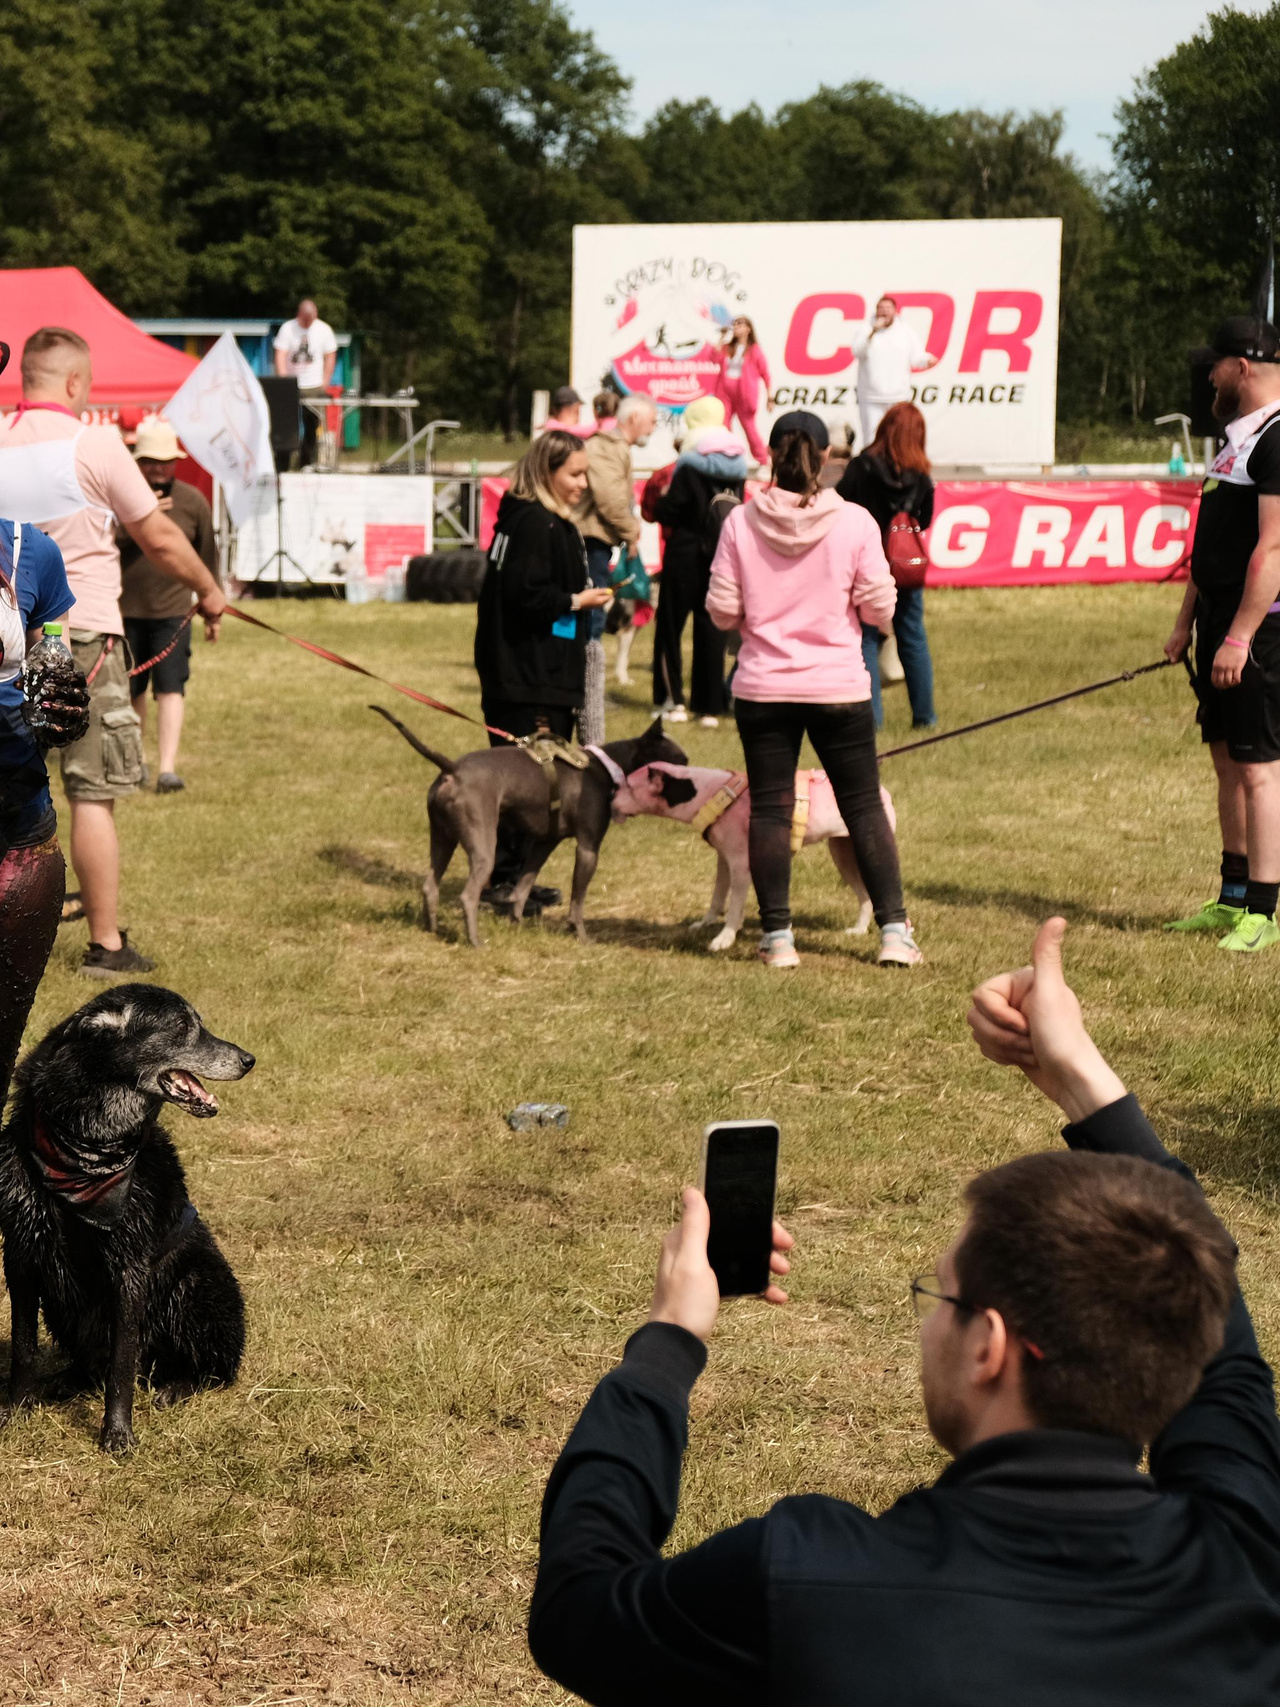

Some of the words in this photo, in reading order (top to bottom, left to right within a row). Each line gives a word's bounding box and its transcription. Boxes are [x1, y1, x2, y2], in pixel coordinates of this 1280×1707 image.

[774, 387, 858, 405] CRAZ
[949, 384, 1025, 404] RACE
[1011, 505, 1190, 568] RAC
